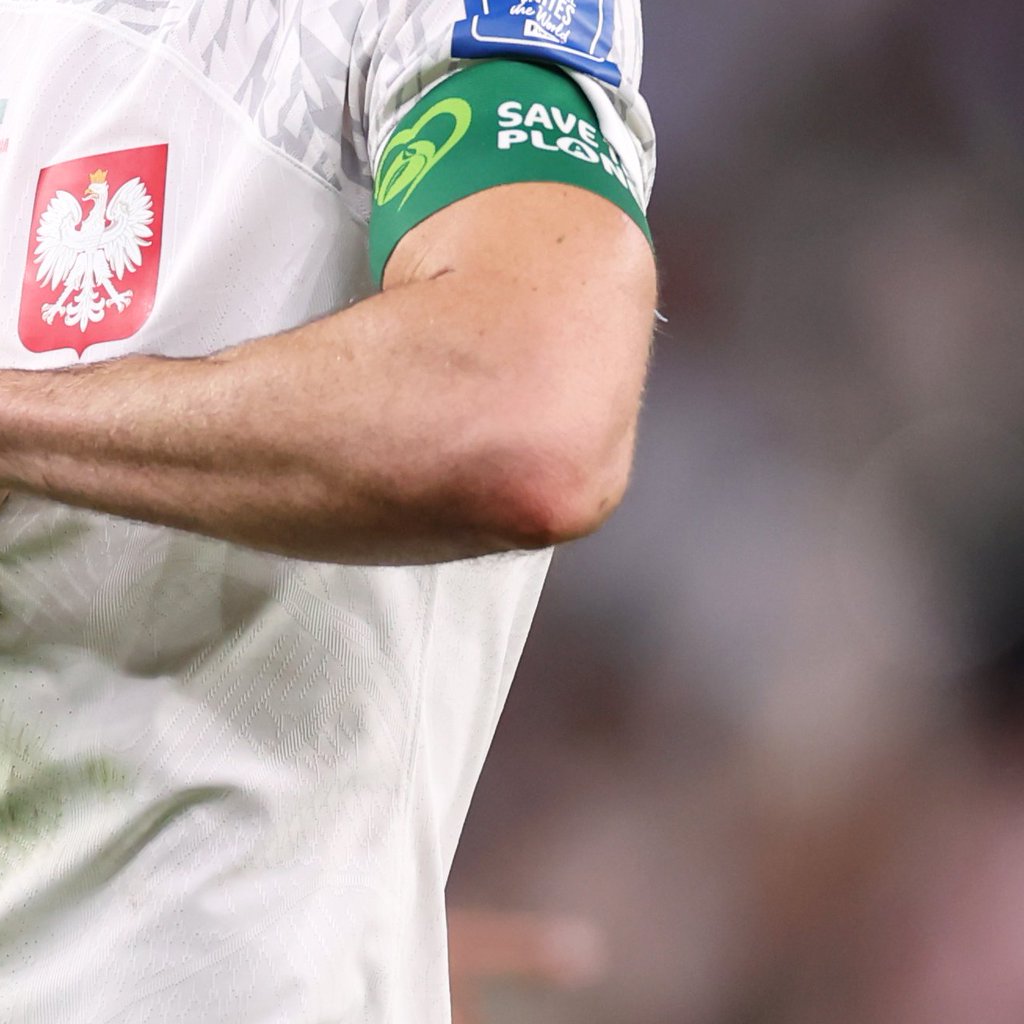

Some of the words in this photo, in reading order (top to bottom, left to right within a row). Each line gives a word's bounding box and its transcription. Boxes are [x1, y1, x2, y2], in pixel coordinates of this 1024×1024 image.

[510, 2, 536, 15] the
[536, 5, 571, 44] World
[497, 100, 599, 148] SAVE
[497, 129, 629, 189] PLAN
